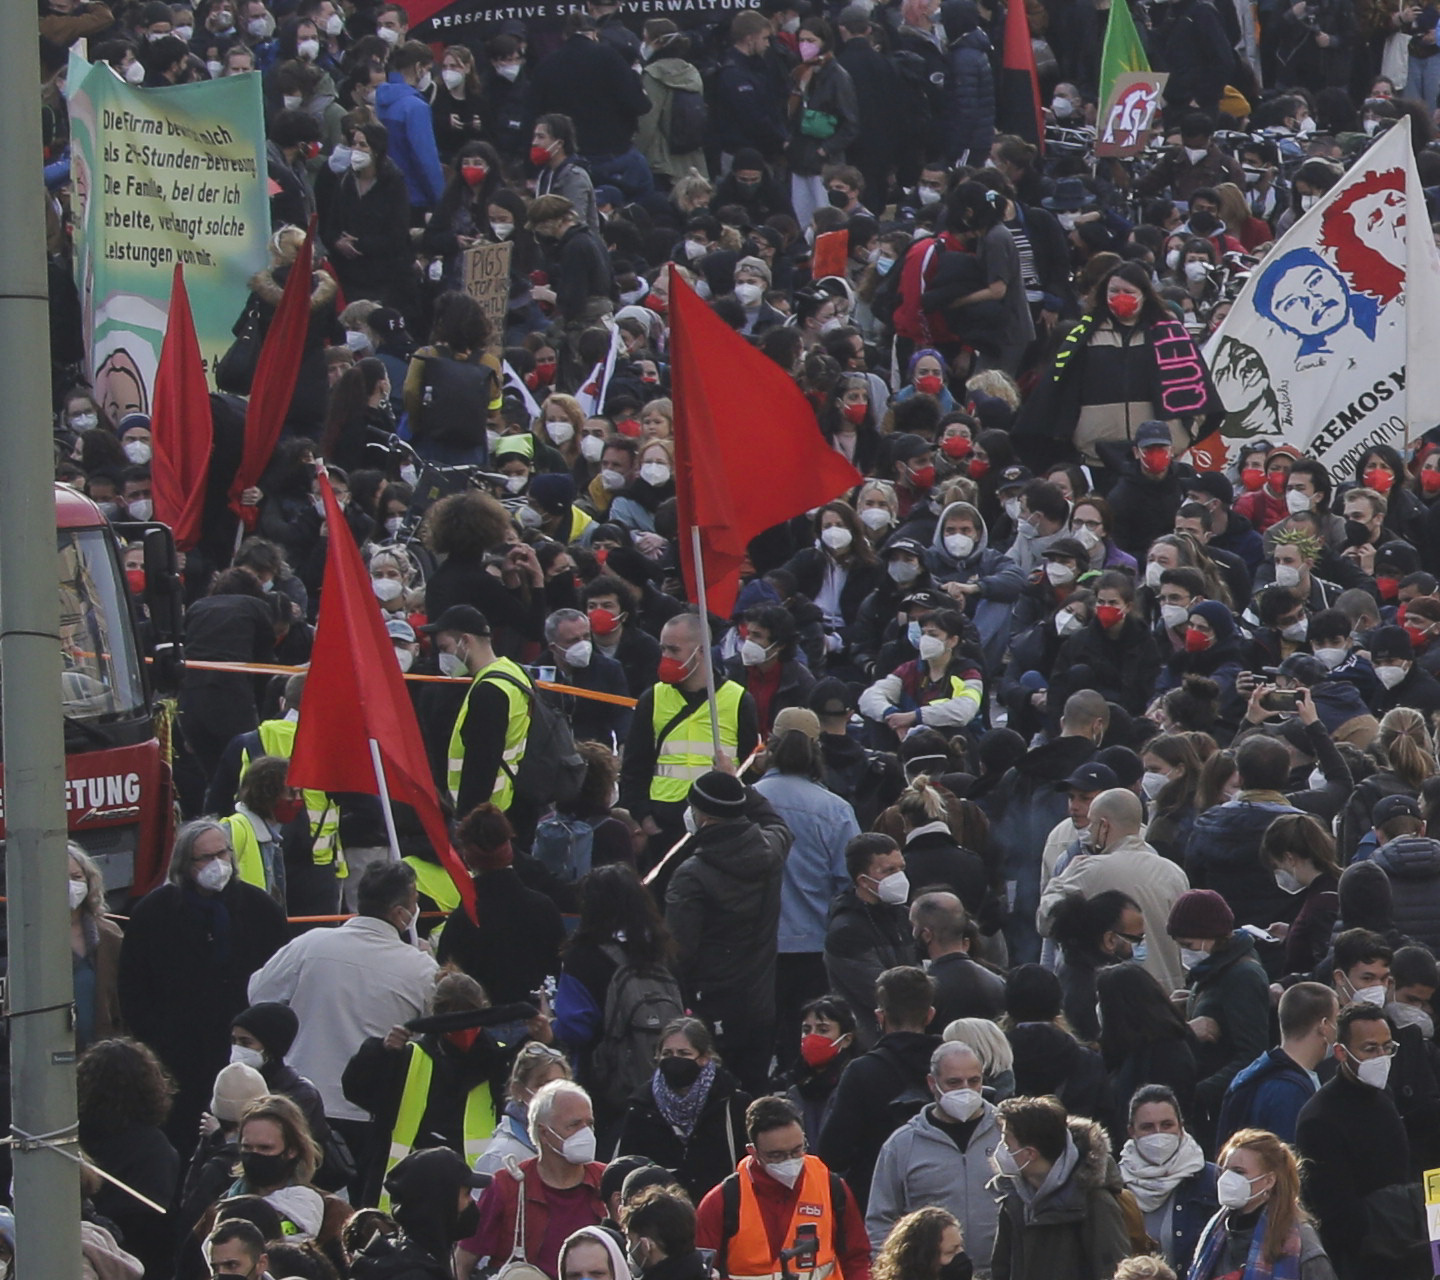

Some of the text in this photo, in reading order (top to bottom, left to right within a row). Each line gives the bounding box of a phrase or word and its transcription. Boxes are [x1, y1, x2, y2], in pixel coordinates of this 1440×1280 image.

[432, 3, 548, 30] PERSPEKTIVE
[171, 180, 194, 202] bei
[197, 181, 220, 204] der
[205, 216, 245, 237] solche
[799, 1205, 822, 1216] rbb
